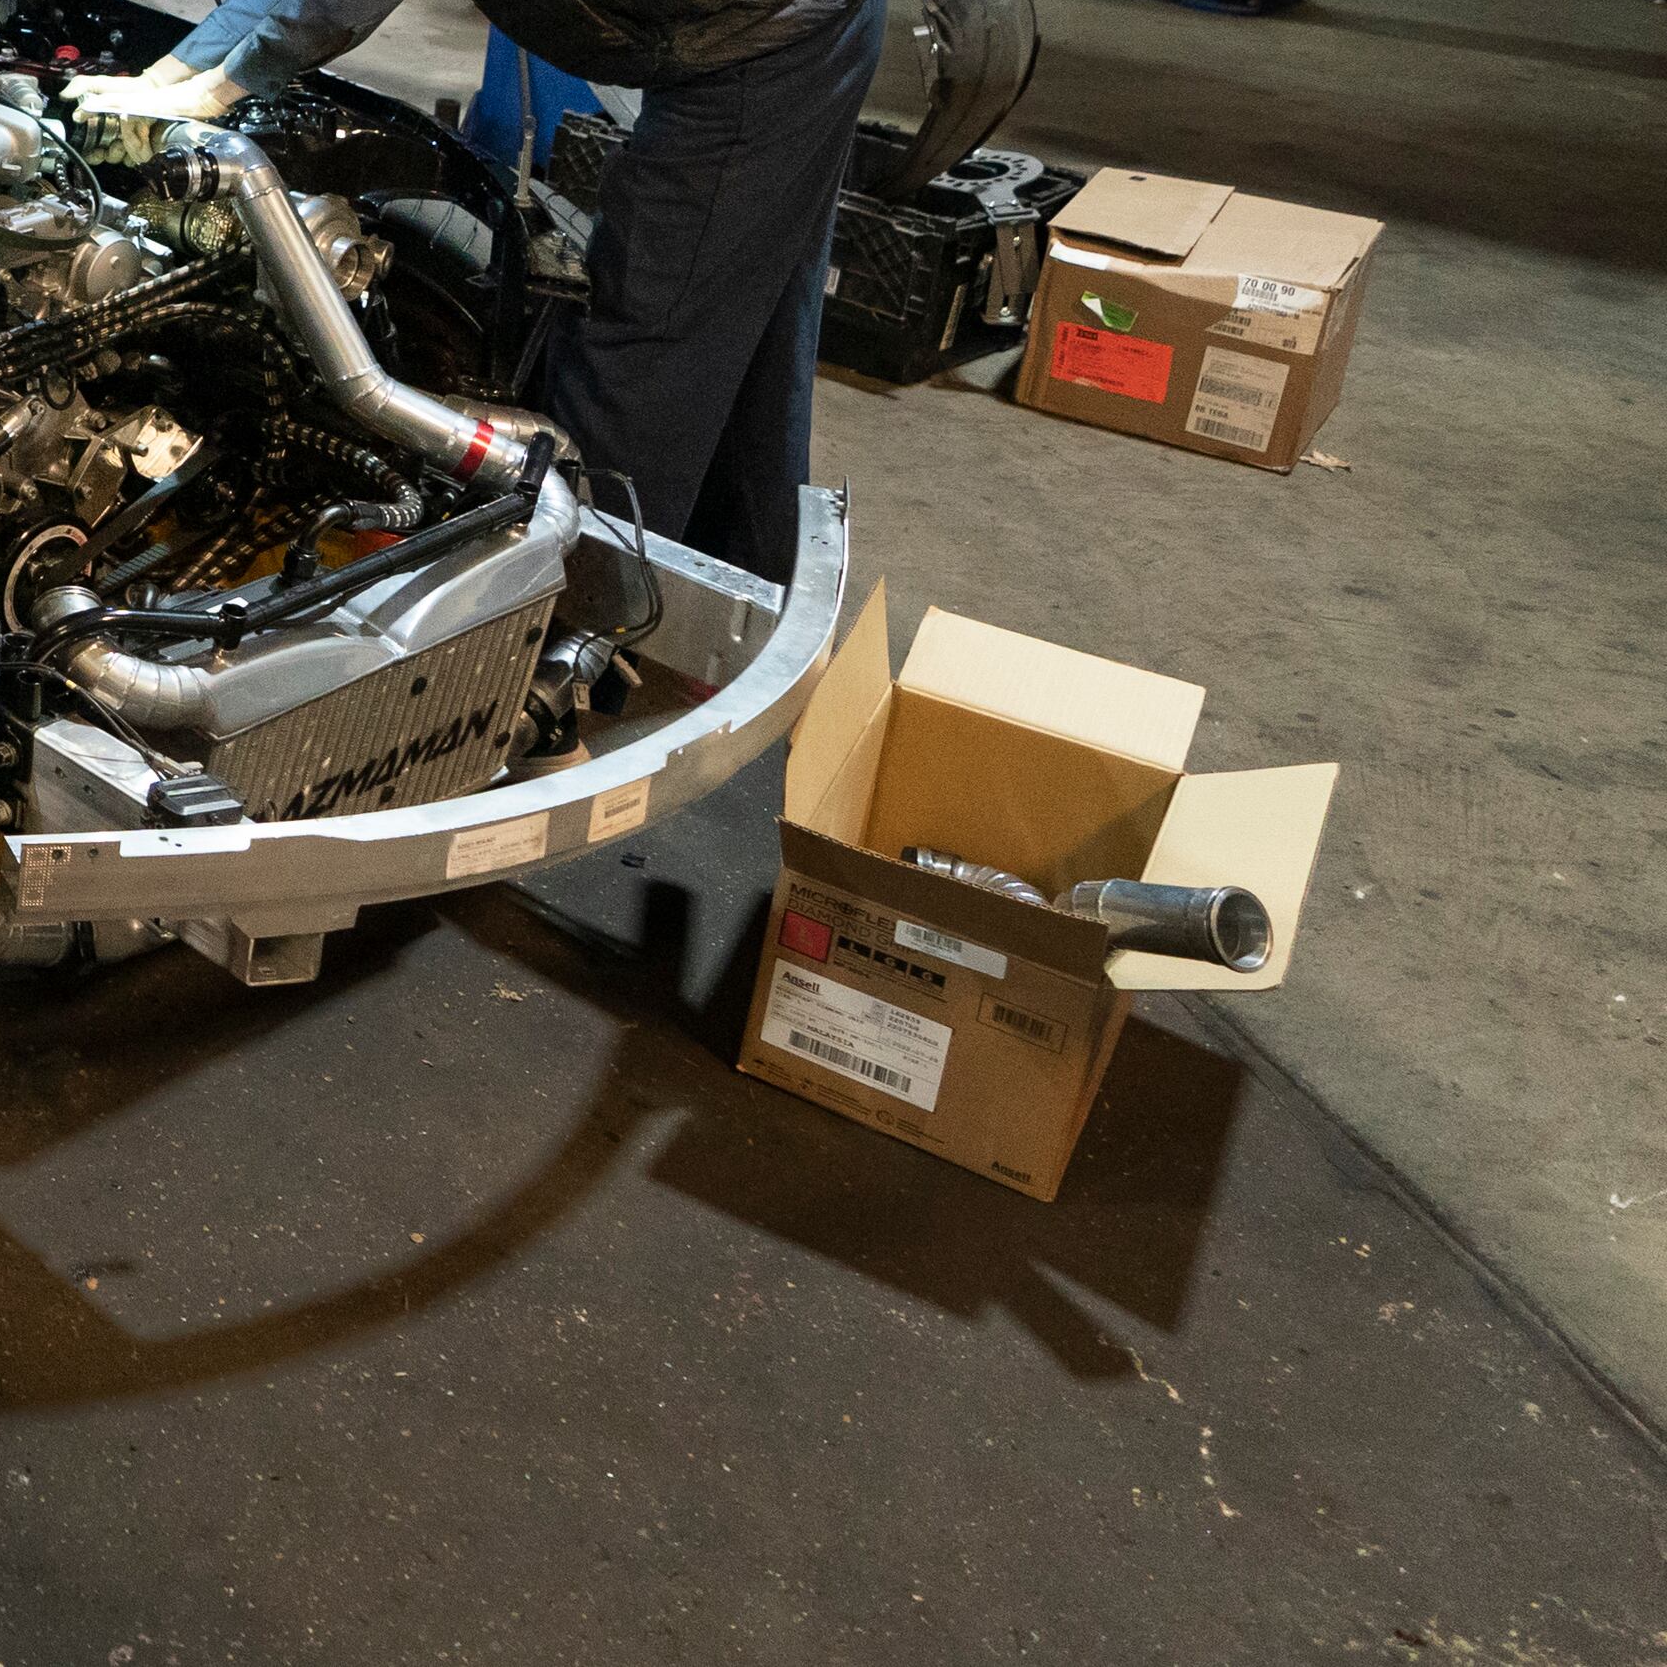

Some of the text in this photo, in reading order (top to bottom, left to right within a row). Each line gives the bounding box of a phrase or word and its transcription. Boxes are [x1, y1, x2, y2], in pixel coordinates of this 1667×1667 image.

[1245, 277, 1296, 297] 70 00 90
[257, 700, 498, 822] AZMAMAN
[782, 971, 820, 993] Ansell
